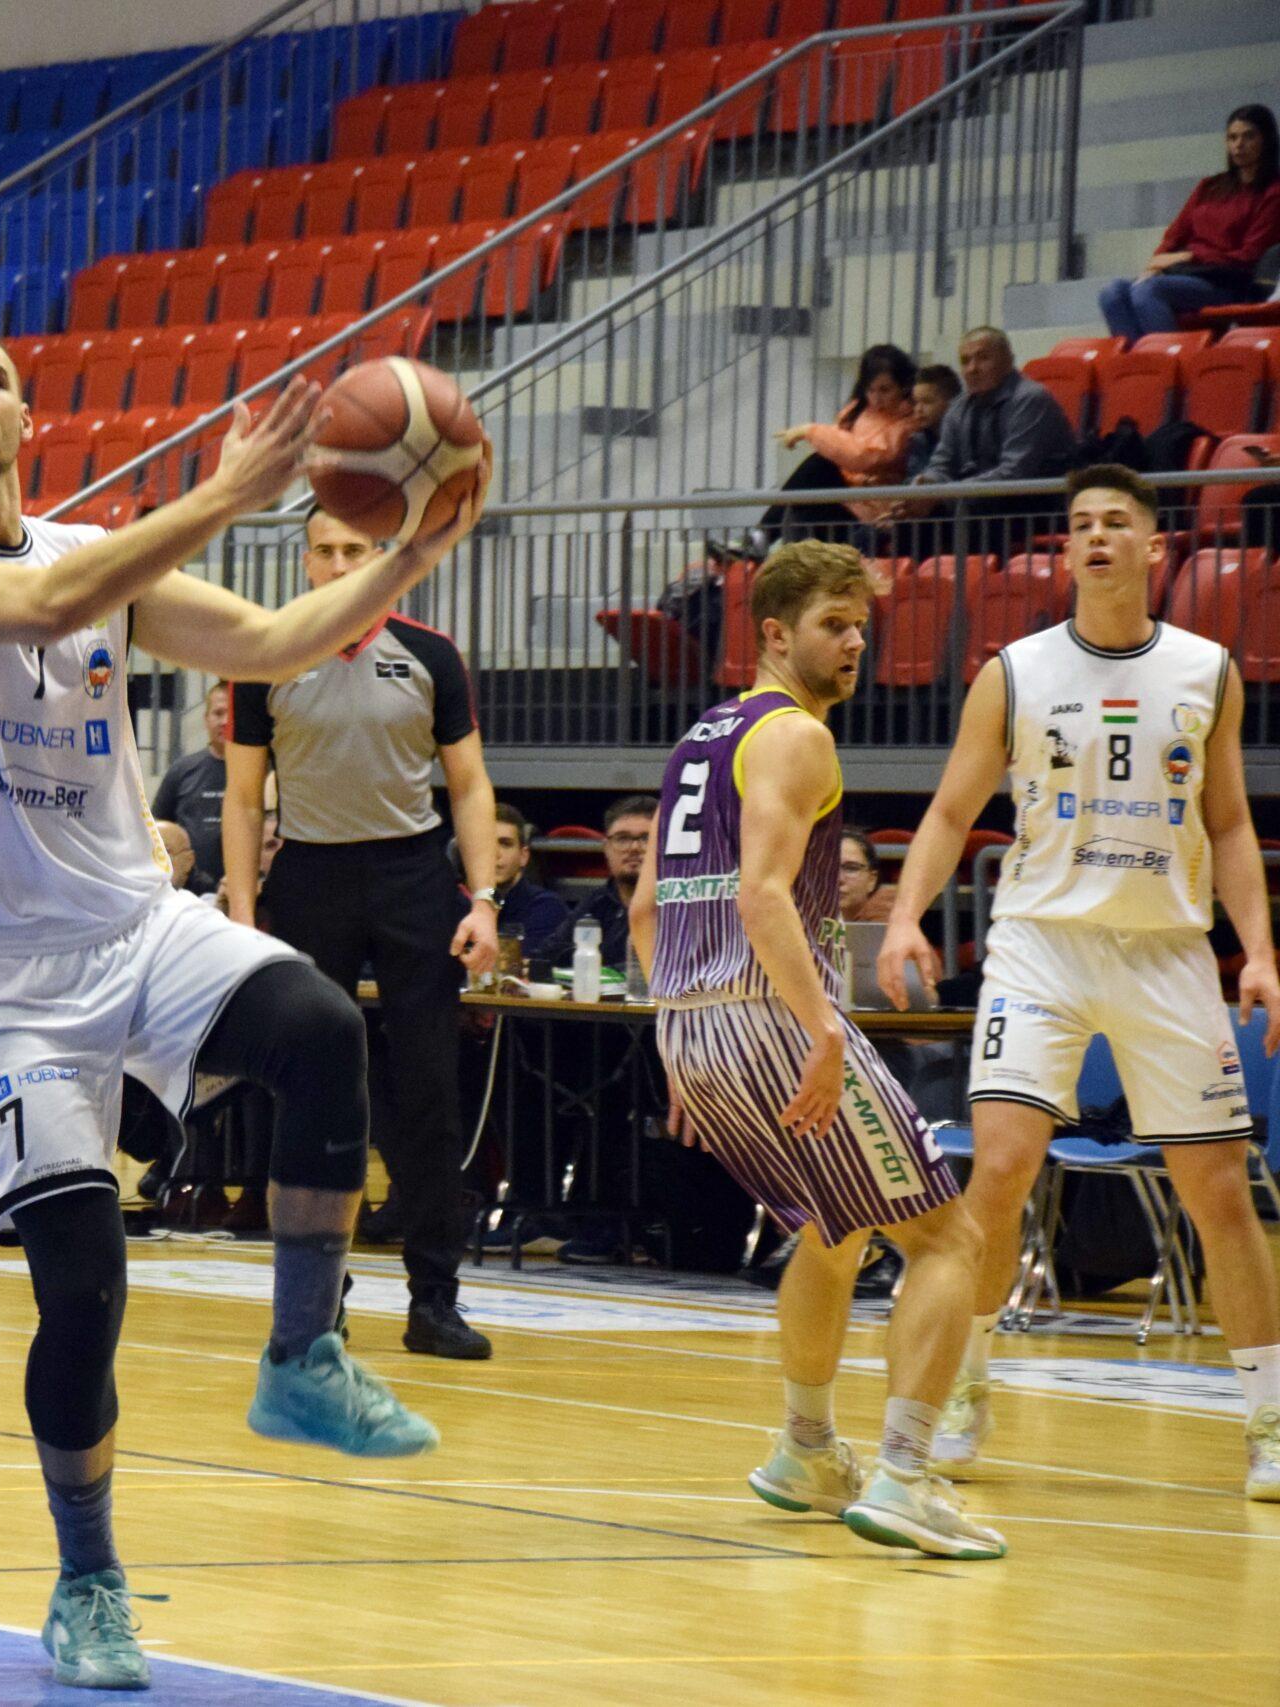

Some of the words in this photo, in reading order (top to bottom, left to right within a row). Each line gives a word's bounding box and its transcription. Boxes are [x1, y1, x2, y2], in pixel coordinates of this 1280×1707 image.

[1049, 702, 1084, 715] JAKO
[1109, 733, 1132, 781] 8
[665, 759, 710, 855] 2
[983, 1016, 1007, 1060] 8
[873, 1141, 911, 1186] FÓT
